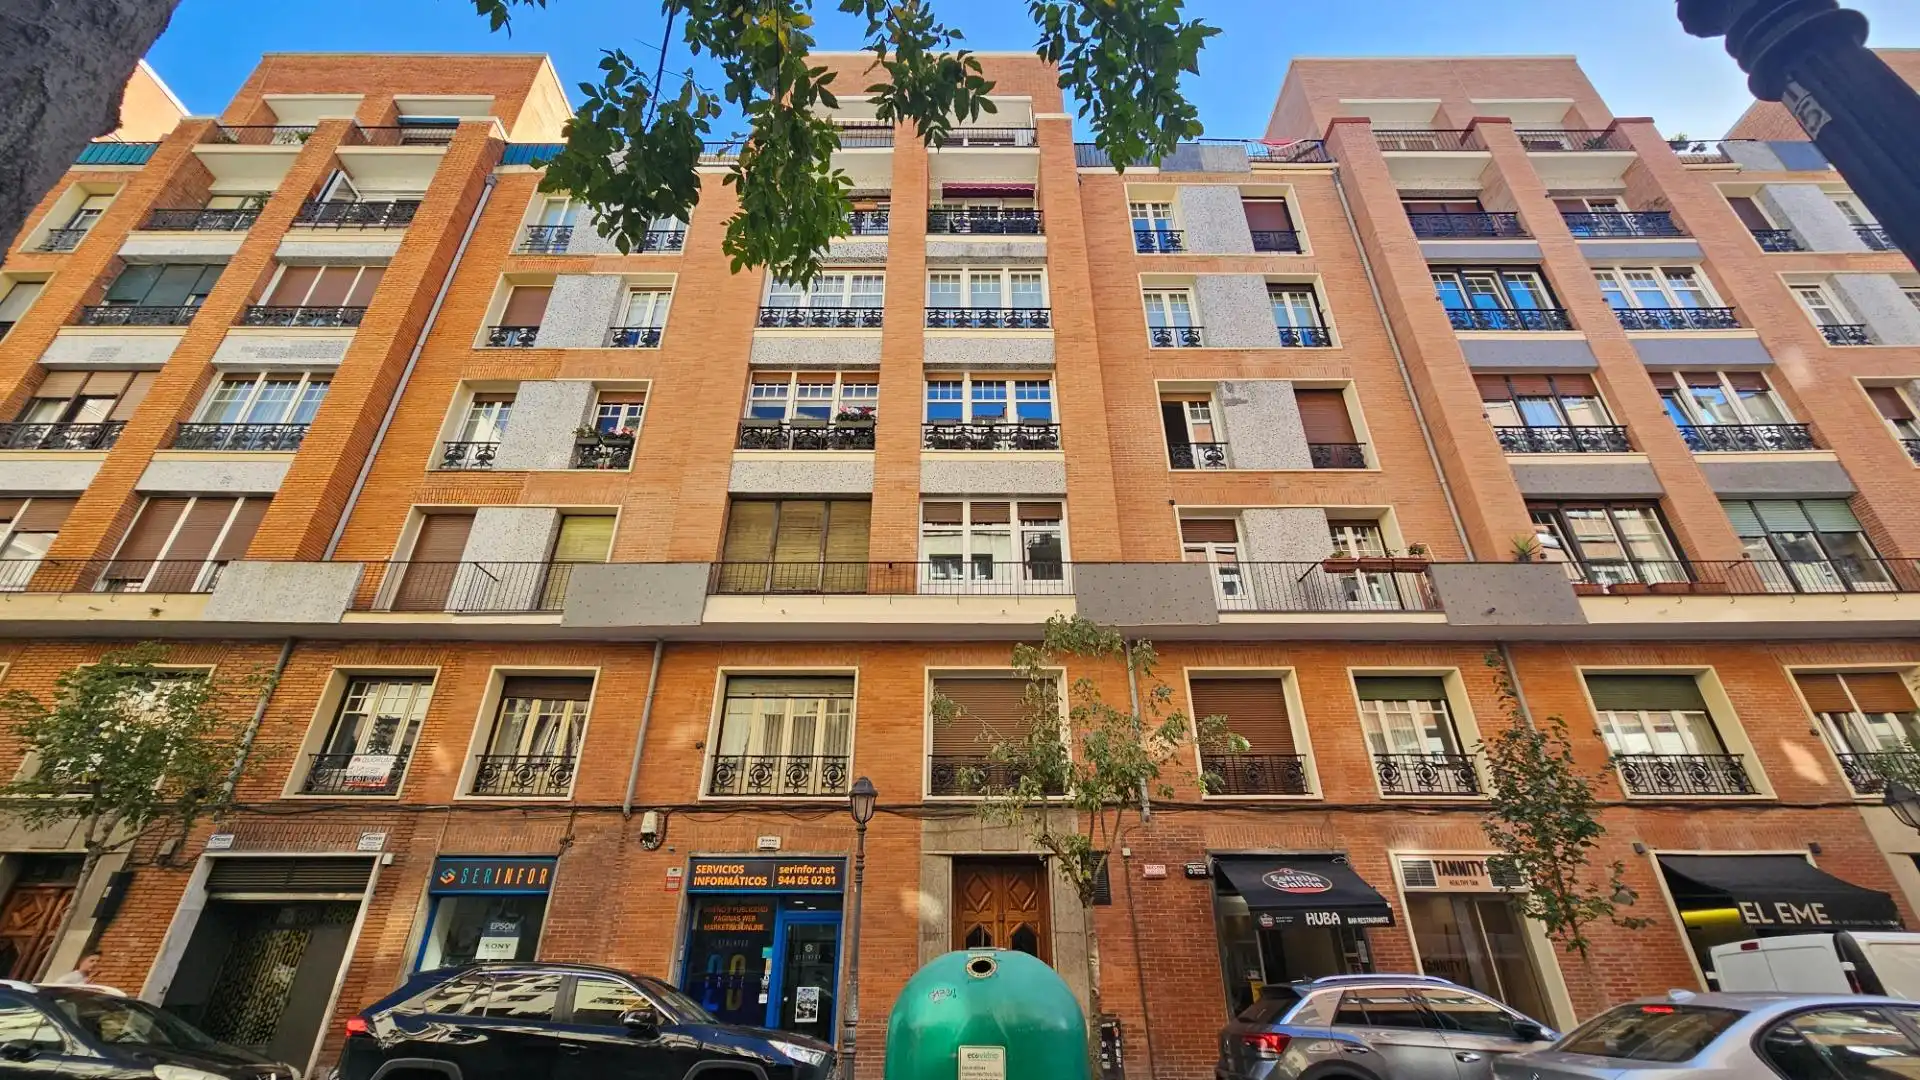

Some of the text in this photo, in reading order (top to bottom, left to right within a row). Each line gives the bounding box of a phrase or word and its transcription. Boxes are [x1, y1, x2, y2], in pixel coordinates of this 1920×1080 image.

[696, 864, 745, 875] SERVICIOS
[779, 864, 835, 875] serinfor.net
[1433, 860, 1484, 877] TANNITY
[460, 867, 549, 885] SERINFOR
[694, 875, 767, 886] INFORMÁTICOS
[778, 876, 836, 886] 944 05 02 01
[1270, 874, 1321, 883] Estrella
[1277, 880, 1325, 889] Galicia
[1305, 912, 1341, 926] HUBA
[1358, 916, 1389, 924] RESTAURANTE
[1738, 902, 1832, 925] EL EME
[490, 922, 516, 930] EPSON
